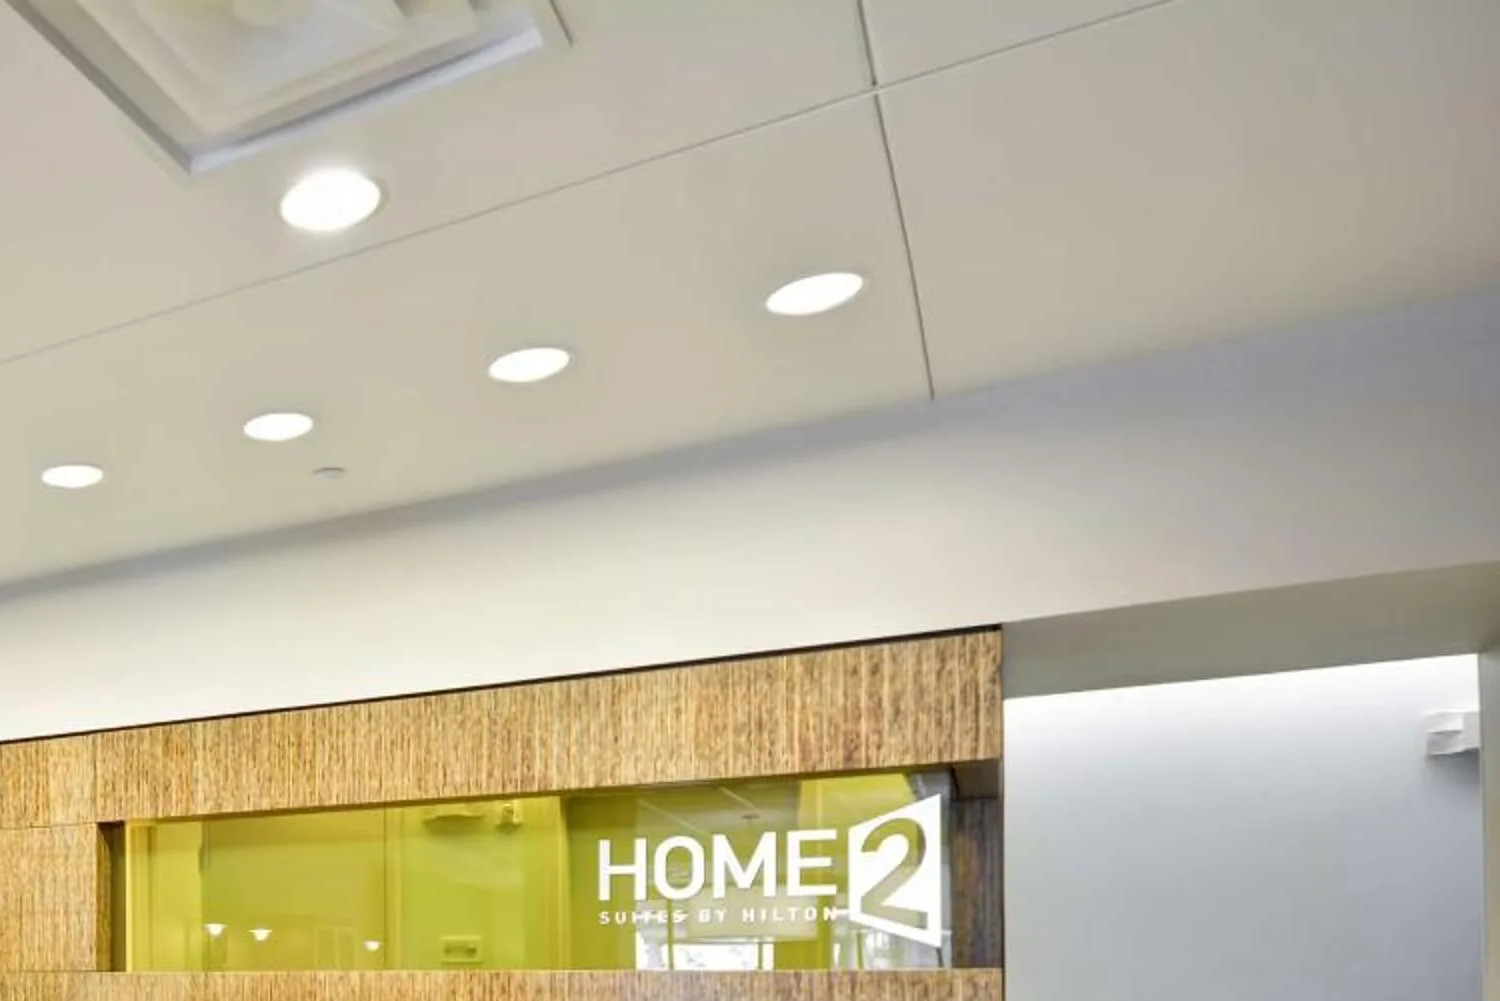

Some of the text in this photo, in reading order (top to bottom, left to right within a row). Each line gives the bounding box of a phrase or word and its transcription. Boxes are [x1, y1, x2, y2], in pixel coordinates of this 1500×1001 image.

[599, 906, 837, 925] SUITES BY HILTON
